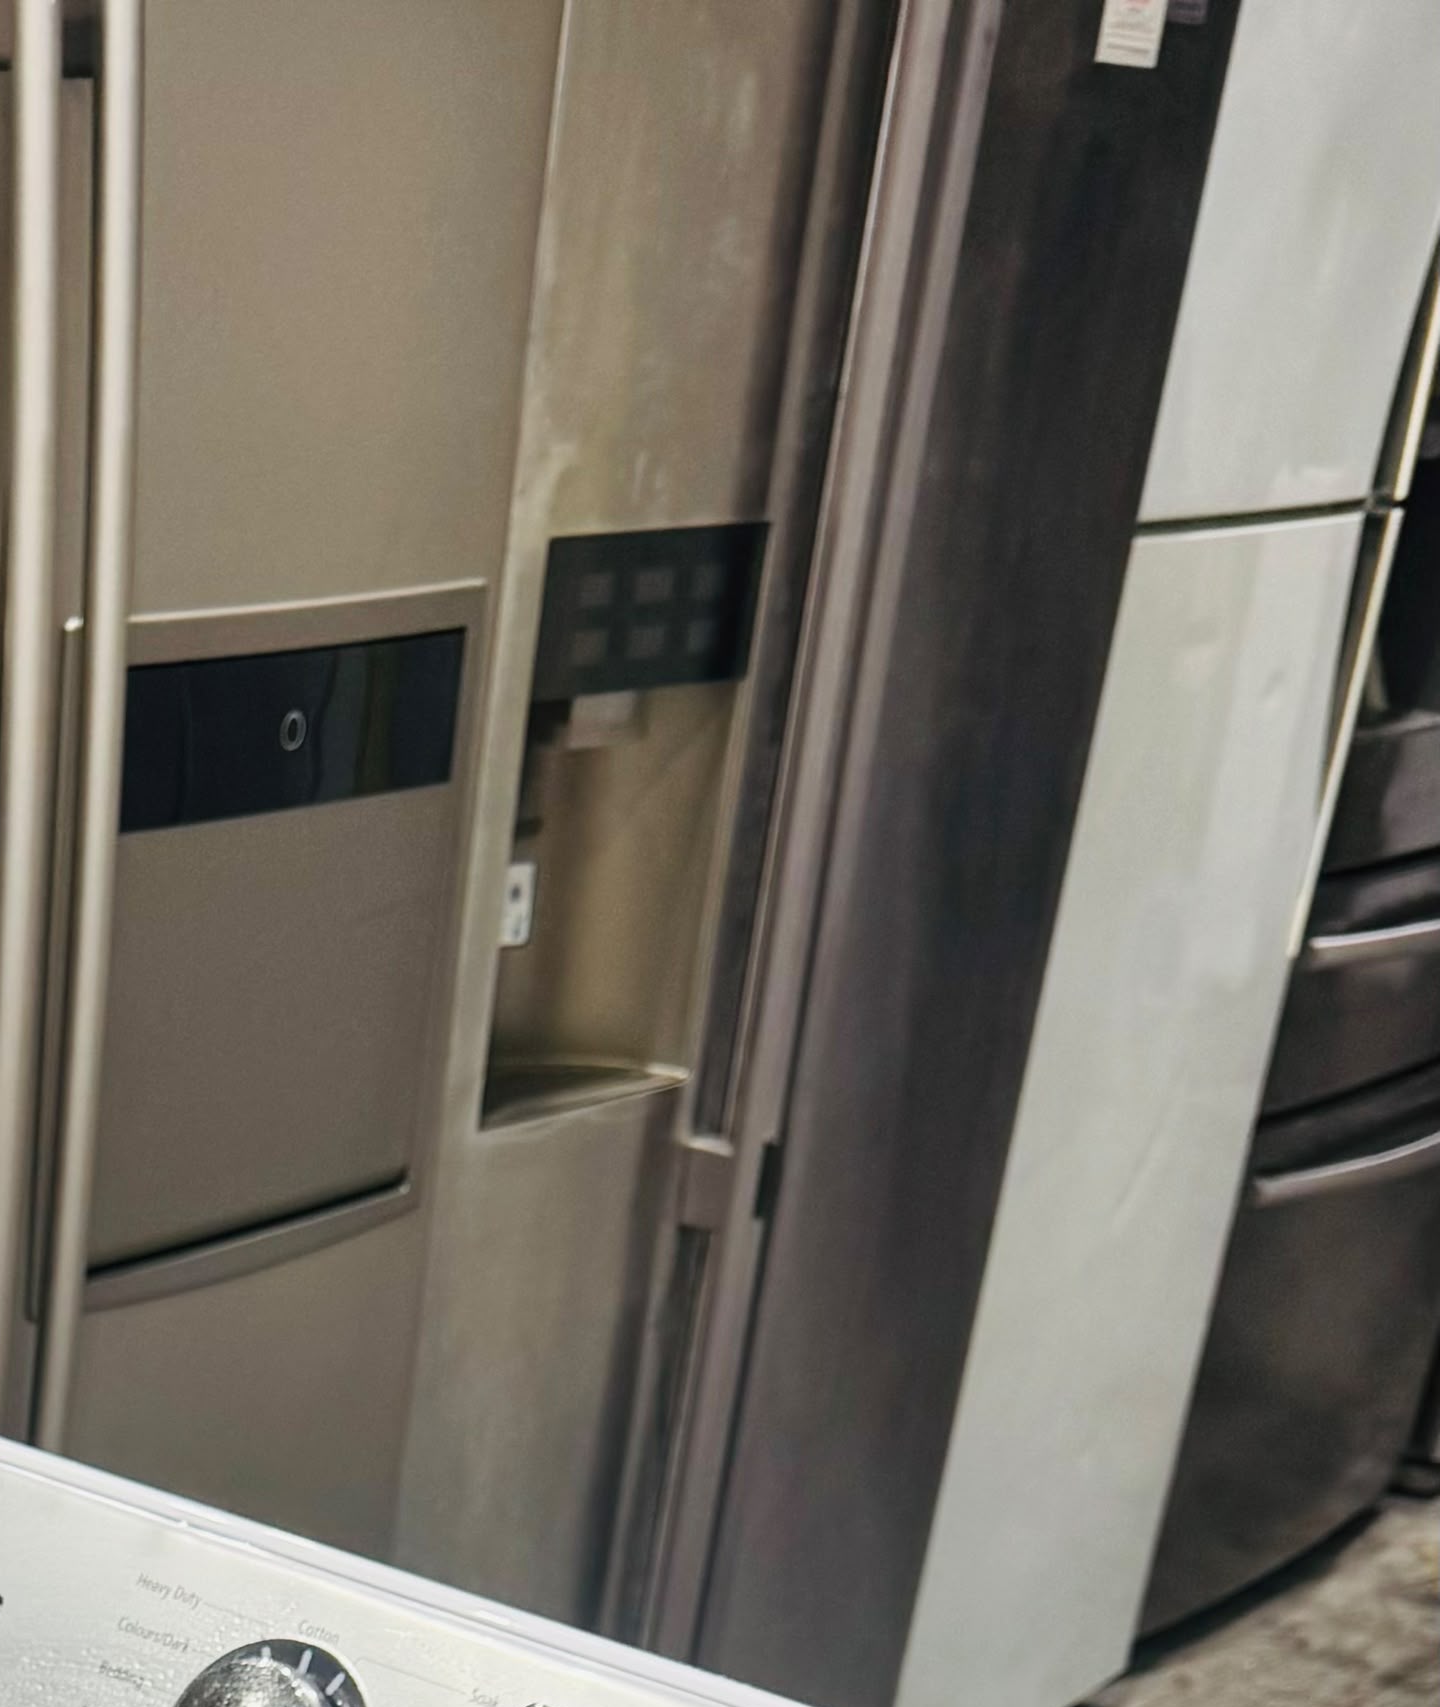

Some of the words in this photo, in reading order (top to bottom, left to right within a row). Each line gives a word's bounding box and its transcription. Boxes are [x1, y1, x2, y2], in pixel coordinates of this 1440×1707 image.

[136, 1573, 170, 1599] Heavy
[173, 1585, 202, 1609] Duty
[298, 1619, 340, 1646] Cotton
